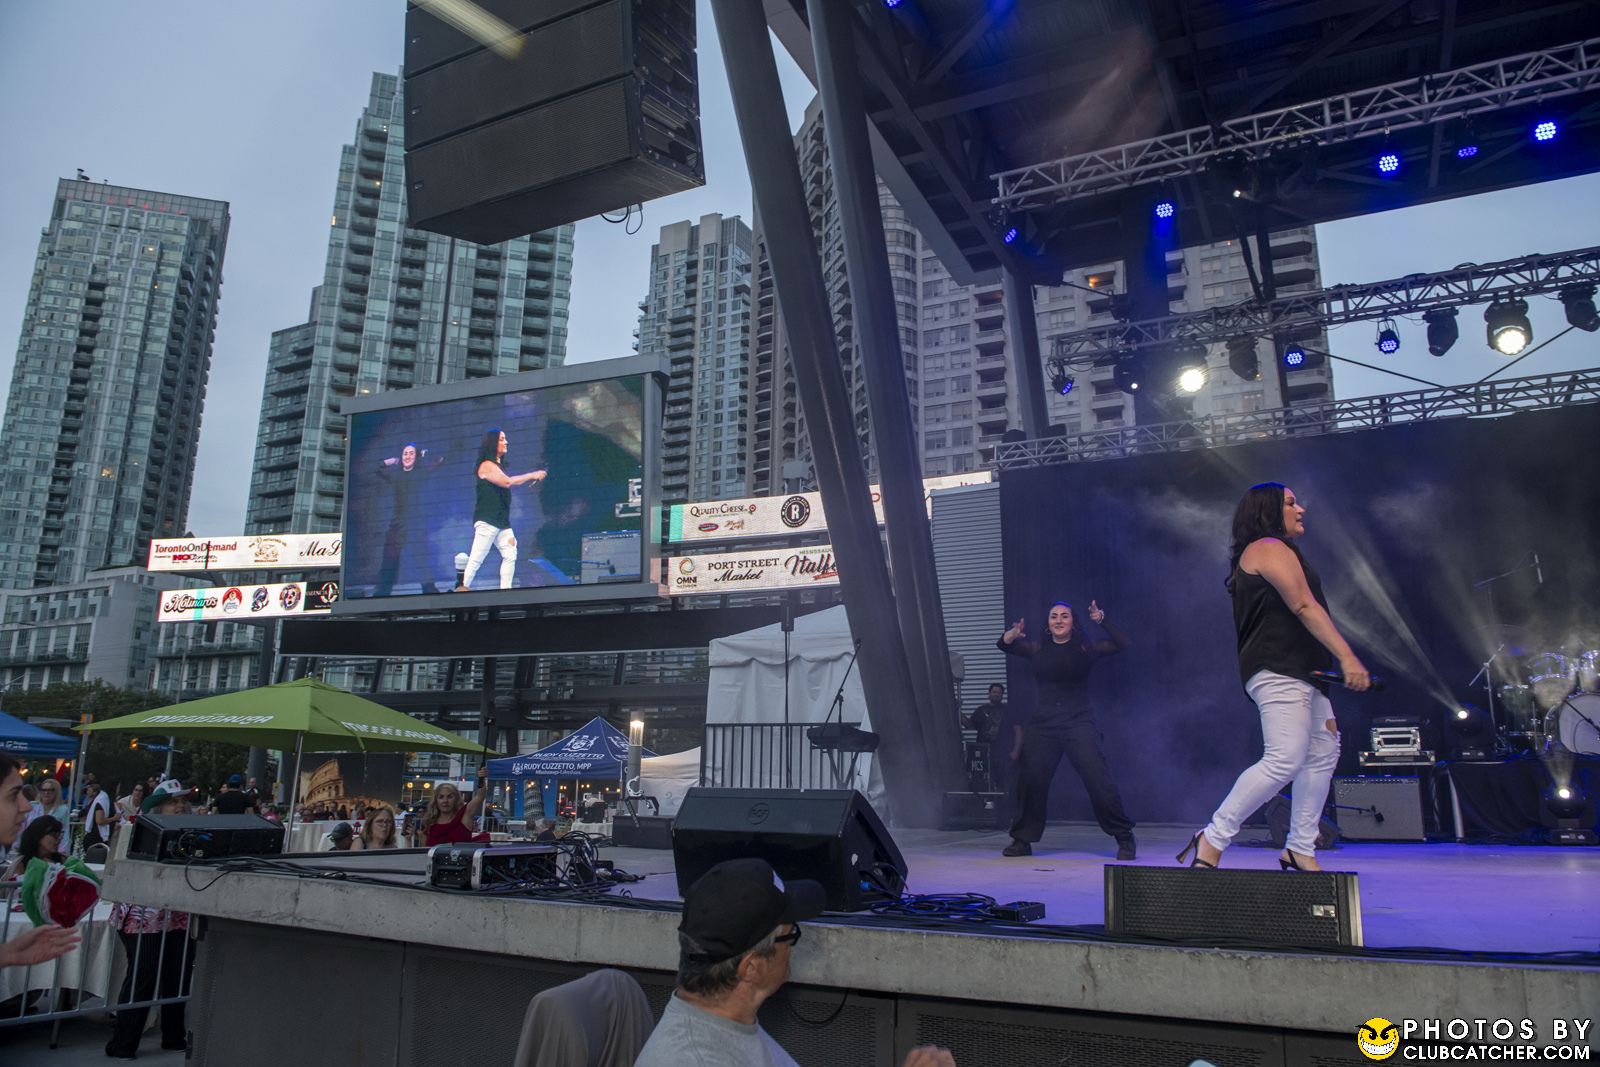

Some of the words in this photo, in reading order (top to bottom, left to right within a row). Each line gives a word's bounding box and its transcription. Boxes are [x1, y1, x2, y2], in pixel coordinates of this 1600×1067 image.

[799, 548, 833, 556] MISSISSAUG
[708, 561, 738, 571] PORT
[738, 558, 780, 569] STREET
[714, 568, 764, 583] Market
[676, 576, 698, 585] OMNI
[523, 762, 541, 770] RUDY
[541, 762, 576, 771] CUZZETTO,
[576, 762, 592, 770] MPP
